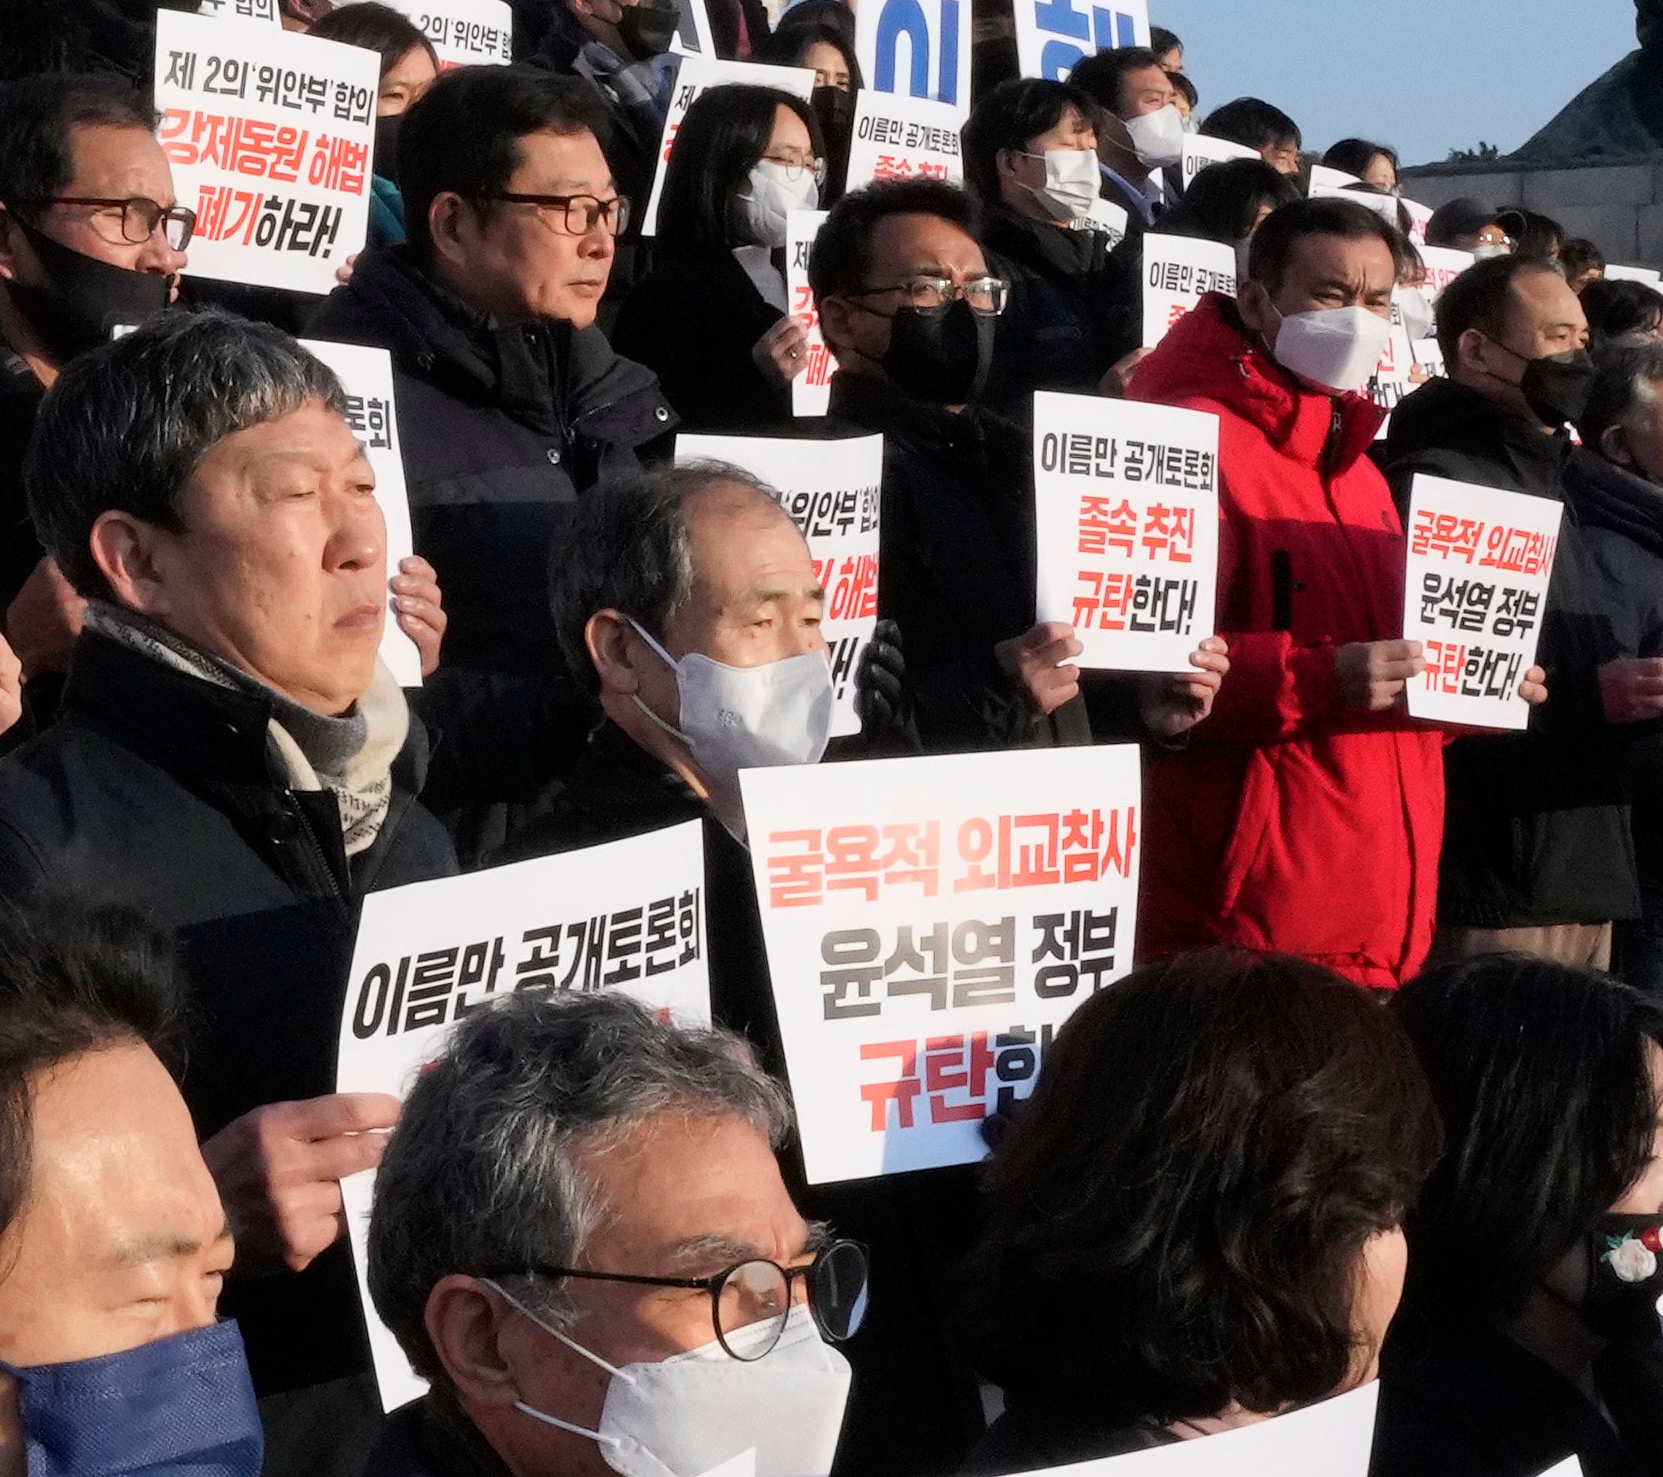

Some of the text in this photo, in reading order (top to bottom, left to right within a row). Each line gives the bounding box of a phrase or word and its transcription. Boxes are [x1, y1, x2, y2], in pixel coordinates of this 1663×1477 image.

[163, 51, 196, 90] 제
[160, 107, 369, 196] 강제동원 해법
[858, 116, 903, 143] 이름만
[192, 185, 343, 259] 폐기하라!
[1150, 261, 1193, 293] 이름만
[1041, 432, 1215, 493] 이름만 공개토론회
[1077, 495, 1195, 564] 졸속 추진
[1412, 509, 1554, 578] 굴욕적 외교참사
[1072, 570, 1198, 635] 규탄한다!
[1420, 573, 1540, 639] 윤석열 정부
[1424, 639, 1523, 702] 규탄한다!
[767, 807, 1136, 910] 굴욕적 외교참사
[352, 887, 701, 1040] 이름만 공개토론회
[819, 907, 1118, 1020] 윤석열 정부
